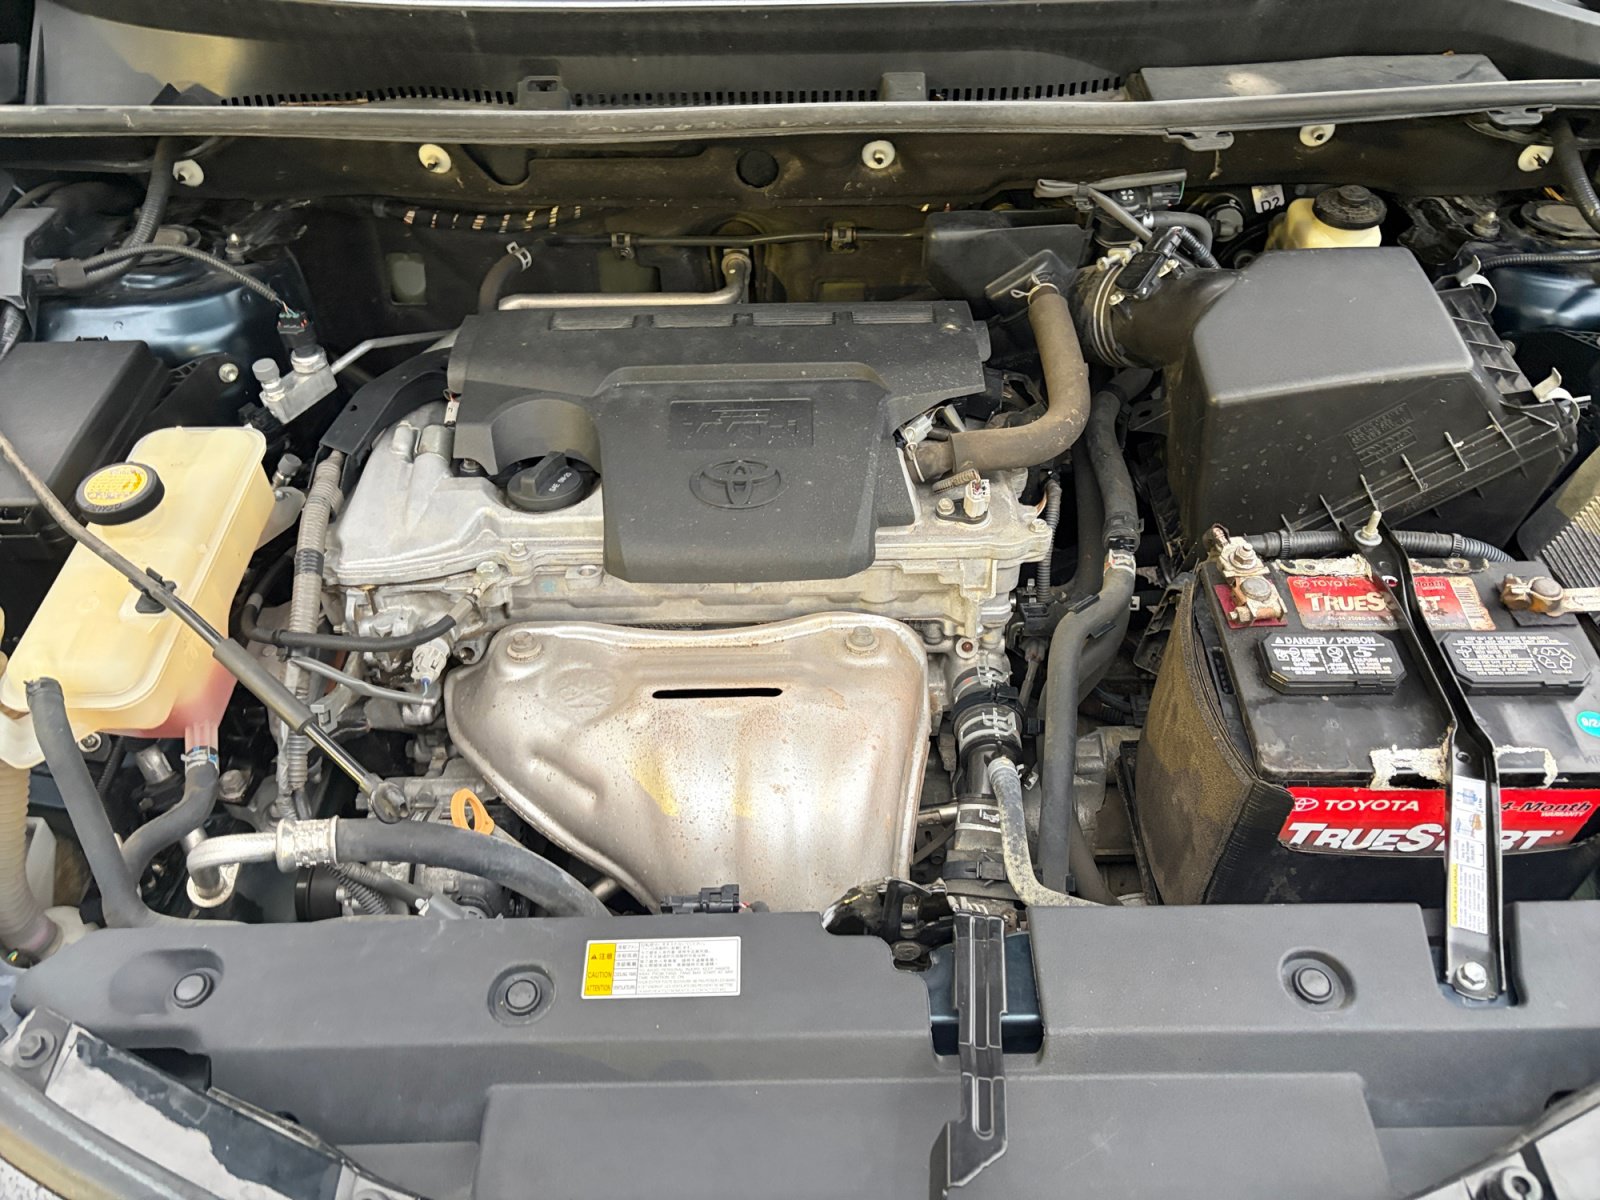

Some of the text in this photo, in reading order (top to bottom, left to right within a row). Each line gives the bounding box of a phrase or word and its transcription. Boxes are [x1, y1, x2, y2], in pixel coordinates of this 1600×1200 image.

[1261, 196, 1280, 213] D2
[1284, 636, 1327, 645] DANGER
[1336, 636, 1376, 644] POISON
[1324, 799, 1420, 812] TOYOTA
[587, 970, 613, 979] CAUTION
[586, 984, 612, 992] ATTENTION
